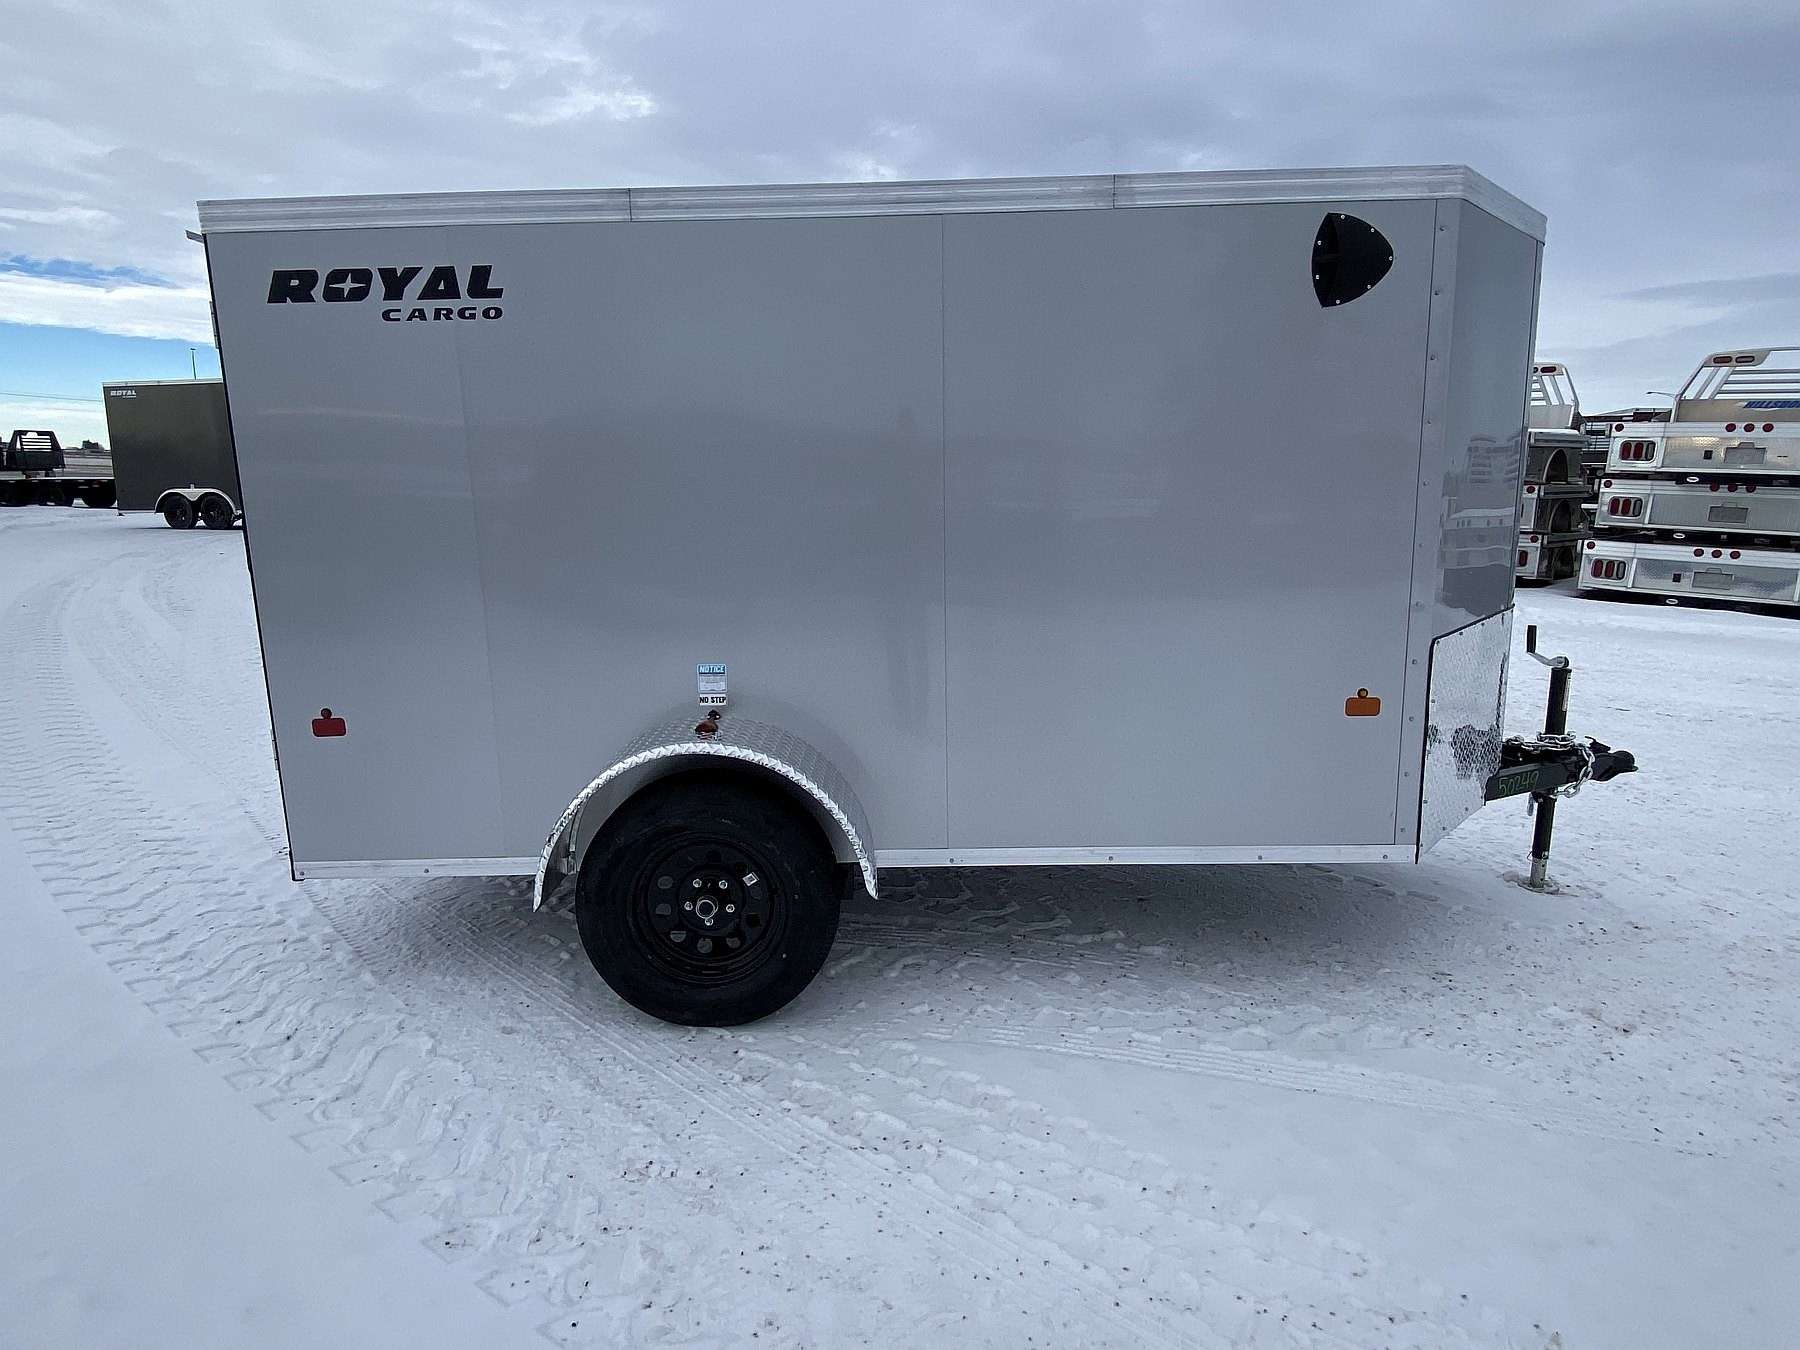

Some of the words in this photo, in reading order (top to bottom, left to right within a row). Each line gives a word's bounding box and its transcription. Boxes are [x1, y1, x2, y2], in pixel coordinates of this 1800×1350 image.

[267, 265, 504, 304] ROYAL
[381, 306, 503, 322] CARGO
[700, 665, 725, 673] NOTICE
